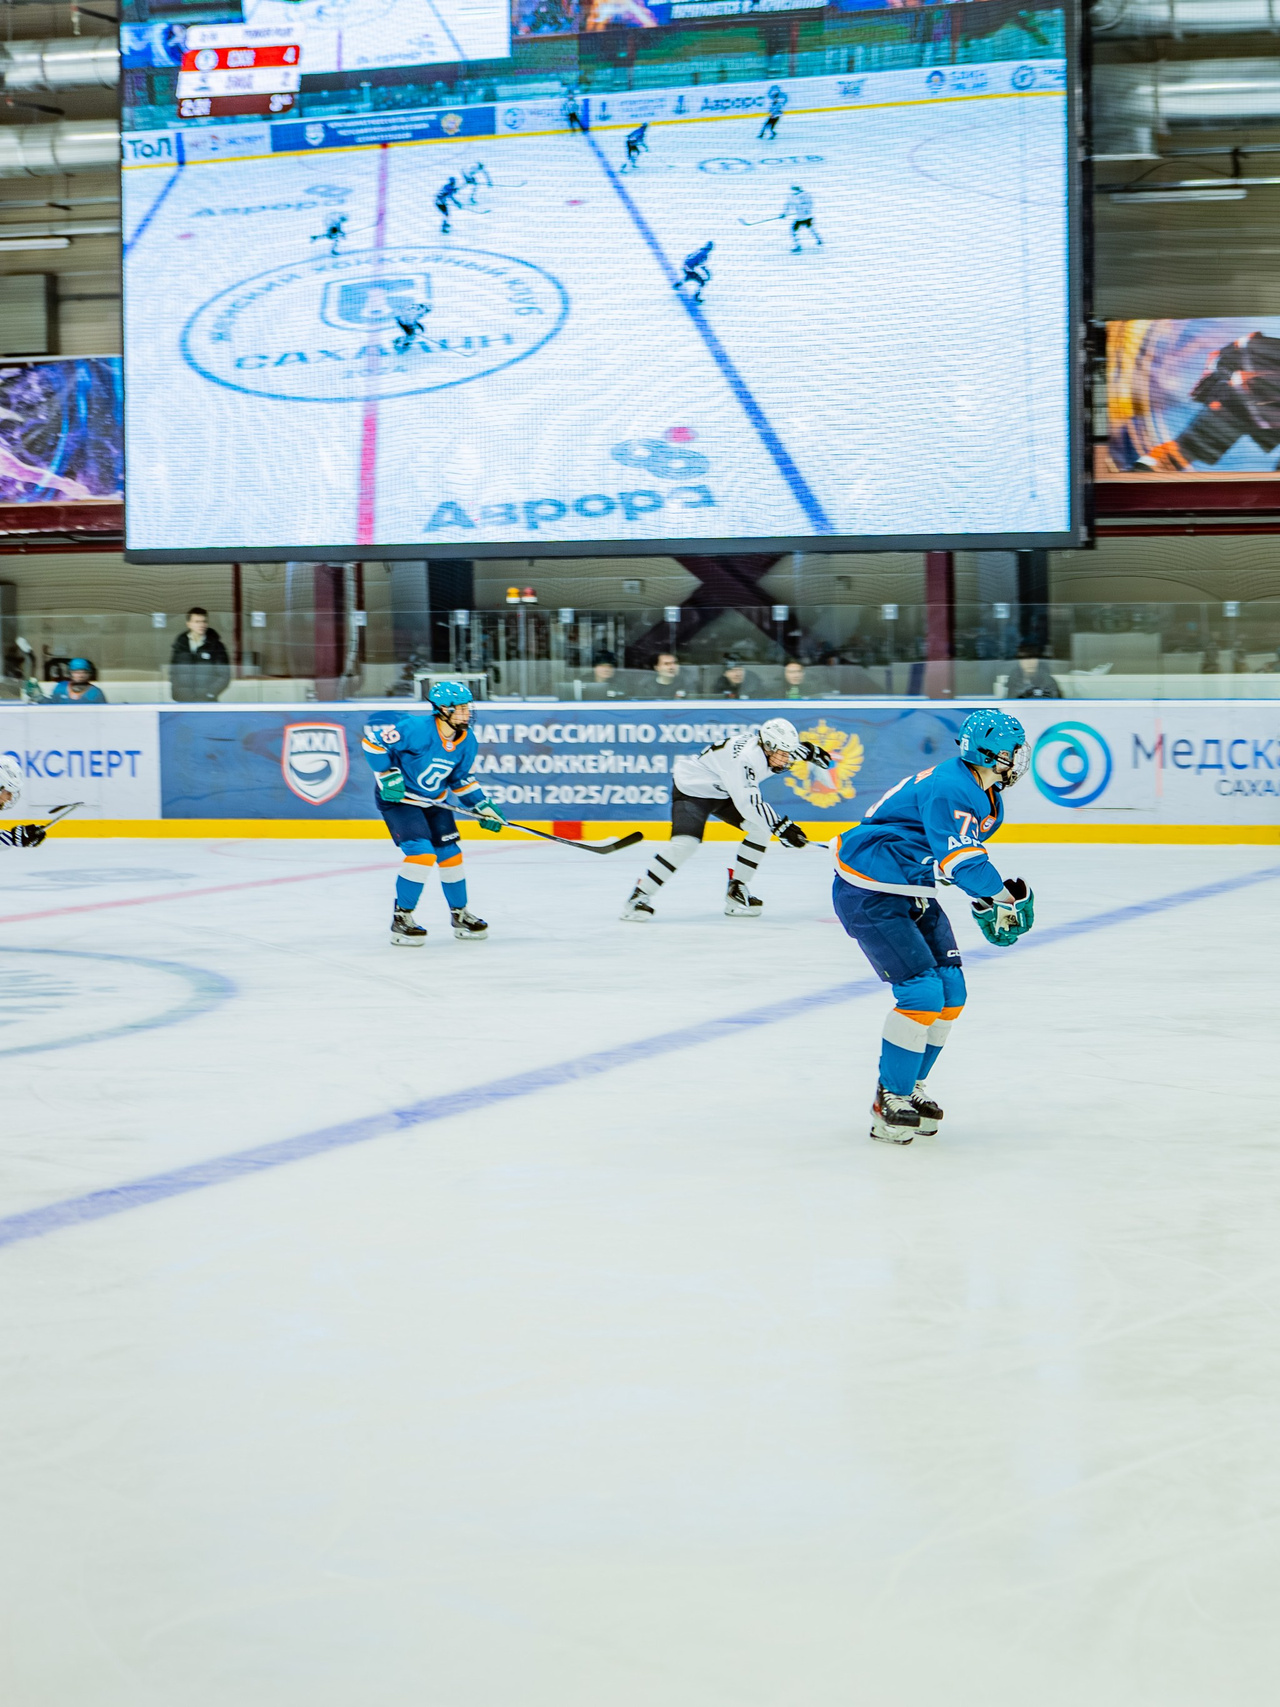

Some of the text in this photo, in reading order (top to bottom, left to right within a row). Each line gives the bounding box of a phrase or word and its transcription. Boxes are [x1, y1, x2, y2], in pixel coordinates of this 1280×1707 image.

[423, 484, 717, 533] Аврора
[514, 724, 614, 743] РОССИИ
[618, 724, 656, 743] ПО
[518, 750, 670, 774] ХОККЕЙНАЯ
[544, 785, 670, 806] 2025/2026
